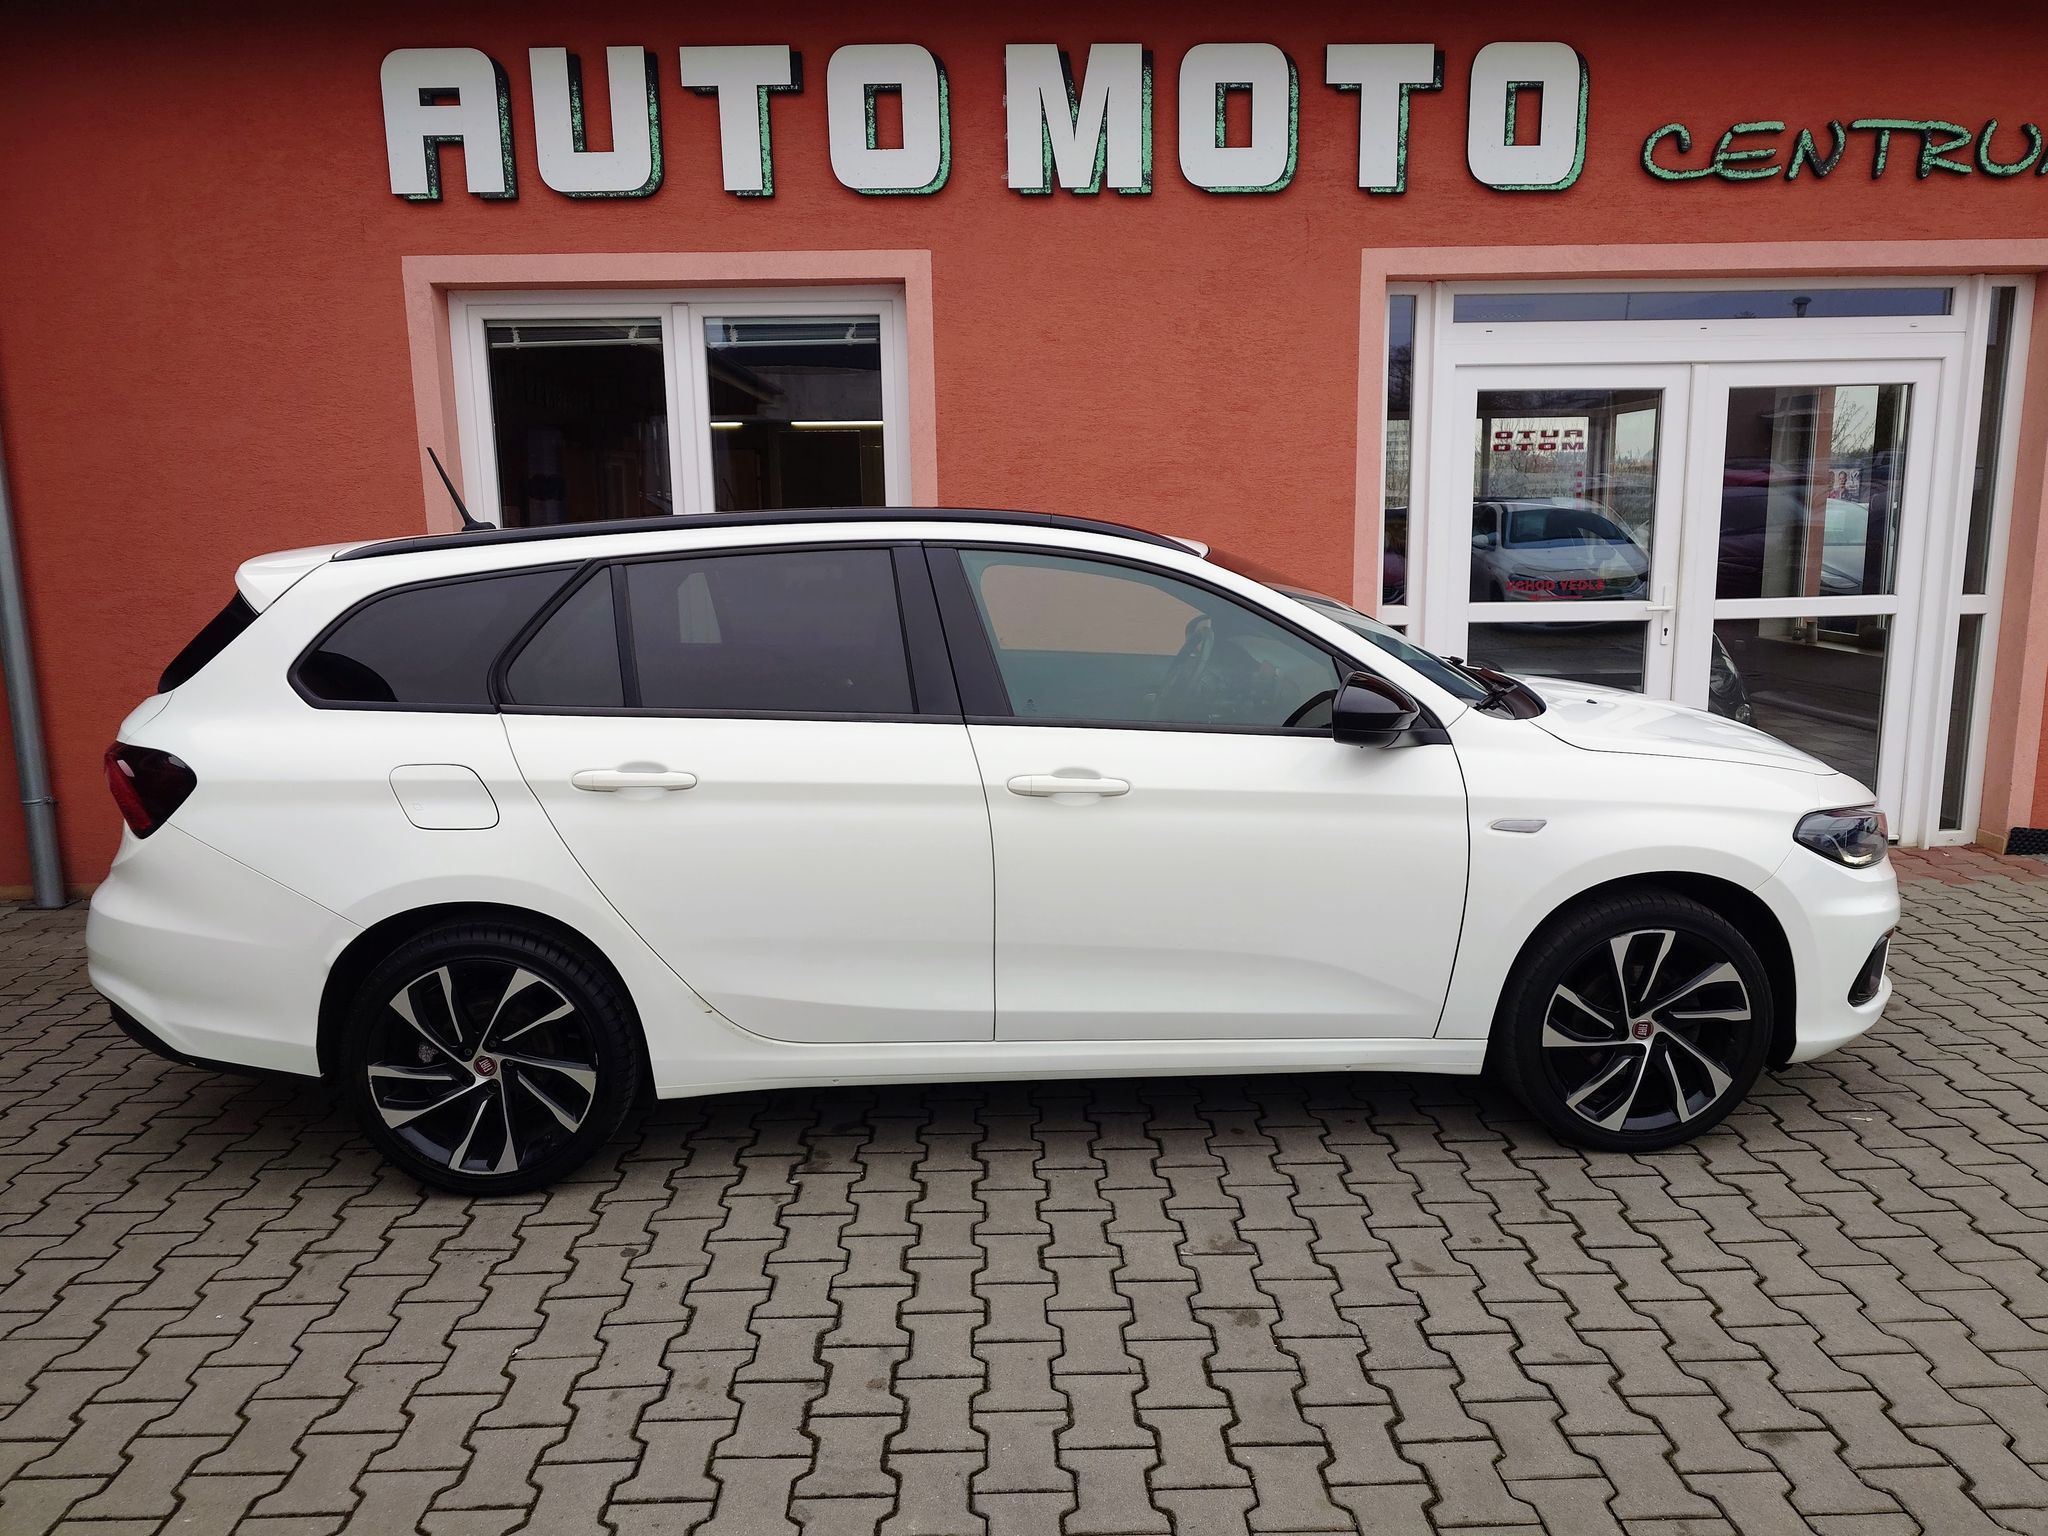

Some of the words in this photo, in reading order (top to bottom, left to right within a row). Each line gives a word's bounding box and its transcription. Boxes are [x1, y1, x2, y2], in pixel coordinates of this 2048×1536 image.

[380, 43, 952, 201] AUTO
[1004, 41, 1590, 195] MOTO
[1640, 117, 2048, 182] CENTRU
